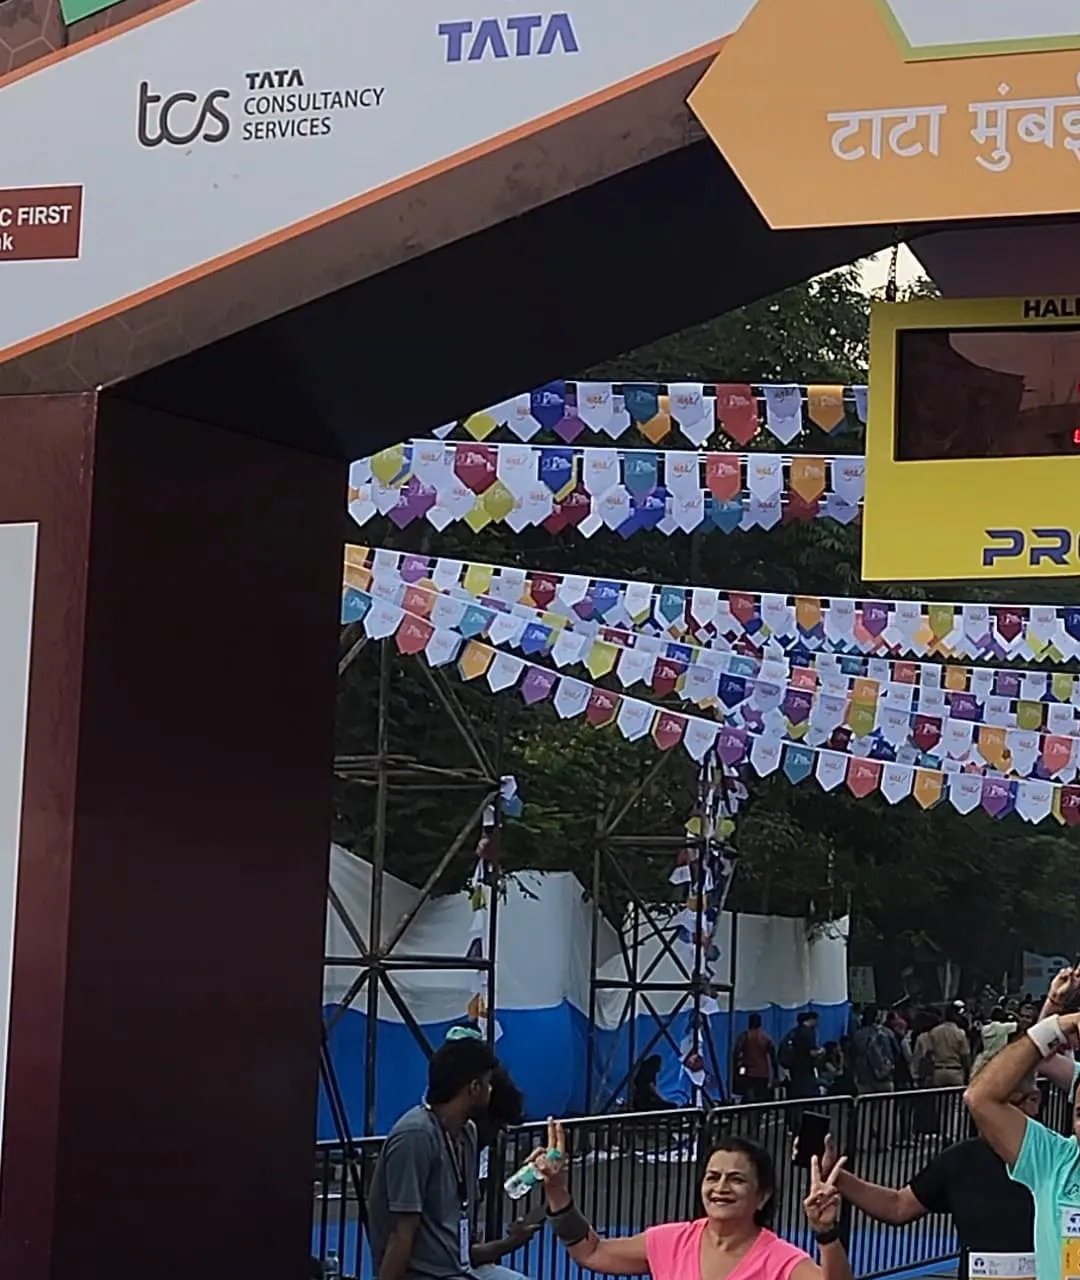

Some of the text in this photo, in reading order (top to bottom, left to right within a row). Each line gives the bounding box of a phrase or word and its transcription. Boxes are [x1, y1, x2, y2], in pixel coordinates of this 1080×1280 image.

[438, 13, 579, 63] TATA
[245, 68, 304, 90] TATA
[138, 81, 230, 147] tcs
[243, 87, 385, 116] CONSULTANCY
[243, 117, 331, 141] SERVICES
[827, 104, 946, 161] टाटा
[17, 205, 72, 226] FIRST
